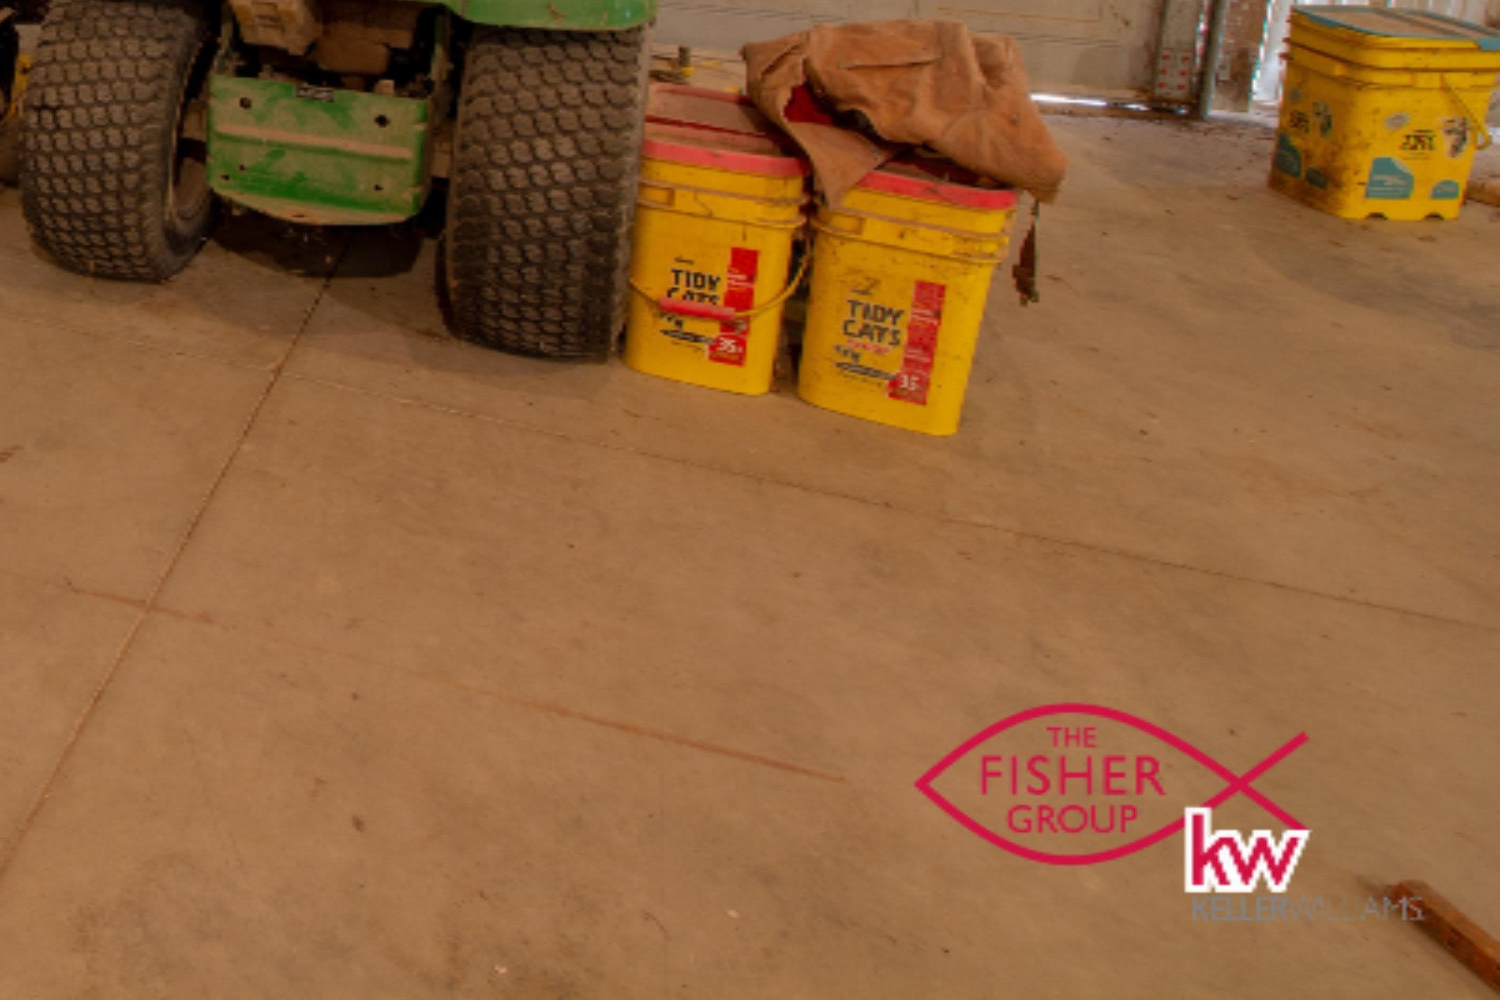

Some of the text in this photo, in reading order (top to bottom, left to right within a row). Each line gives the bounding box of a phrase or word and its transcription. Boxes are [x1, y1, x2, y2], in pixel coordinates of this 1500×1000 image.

[671, 268, 721, 290] TIDY
[846, 299, 904, 325] TIDY
[843, 319, 902, 345] CATS
